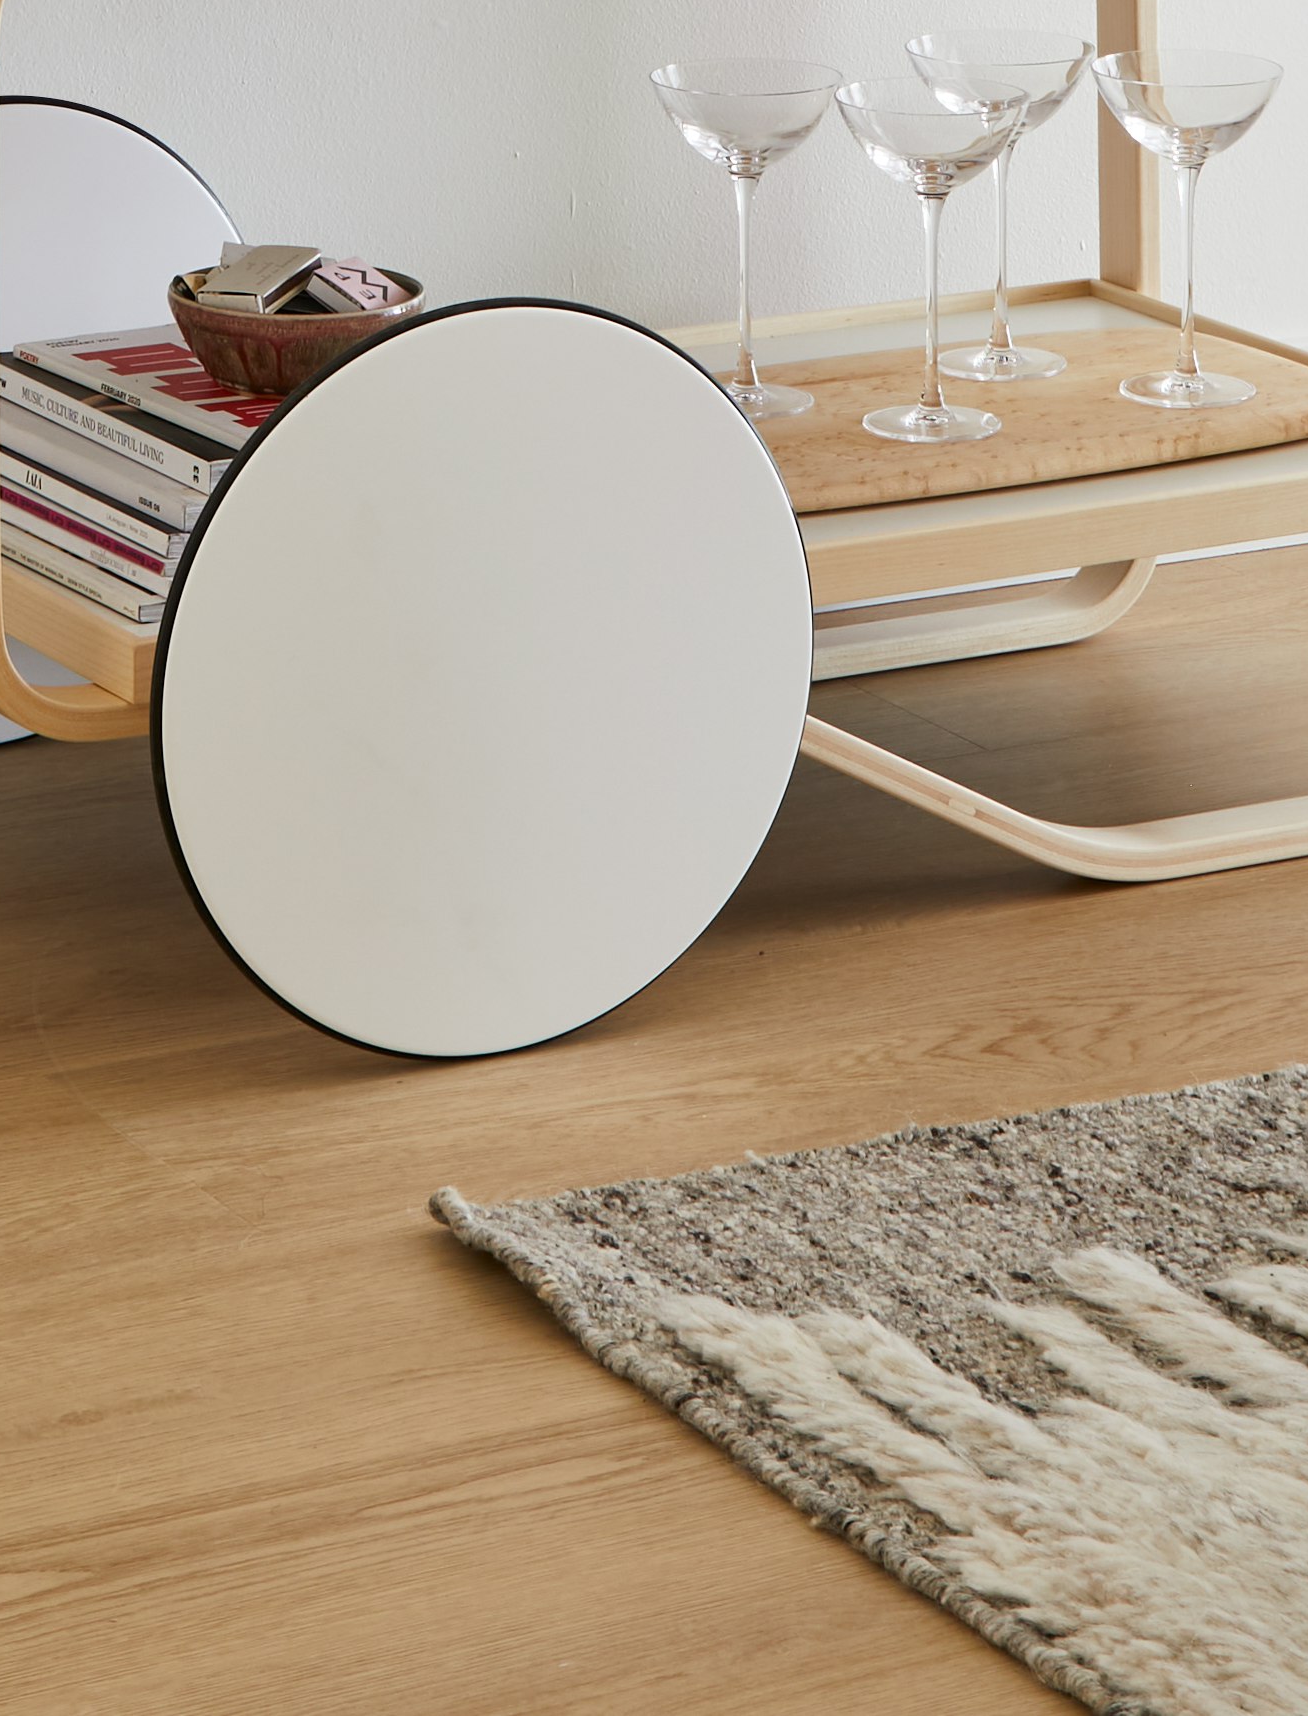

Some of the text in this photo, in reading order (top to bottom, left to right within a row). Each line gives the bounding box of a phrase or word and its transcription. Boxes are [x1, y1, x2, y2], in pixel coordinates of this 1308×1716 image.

[19, 349, 39, 365] POETRY
[100, 382, 141, 407] FEBRUARY 2020
[46, 399, 79, 424] CULTURE
[80, 415, 96, 432] AND
[97, 422, 139, 454] BEAUTIFUL
[139, 441, 165, 465] LIVING
